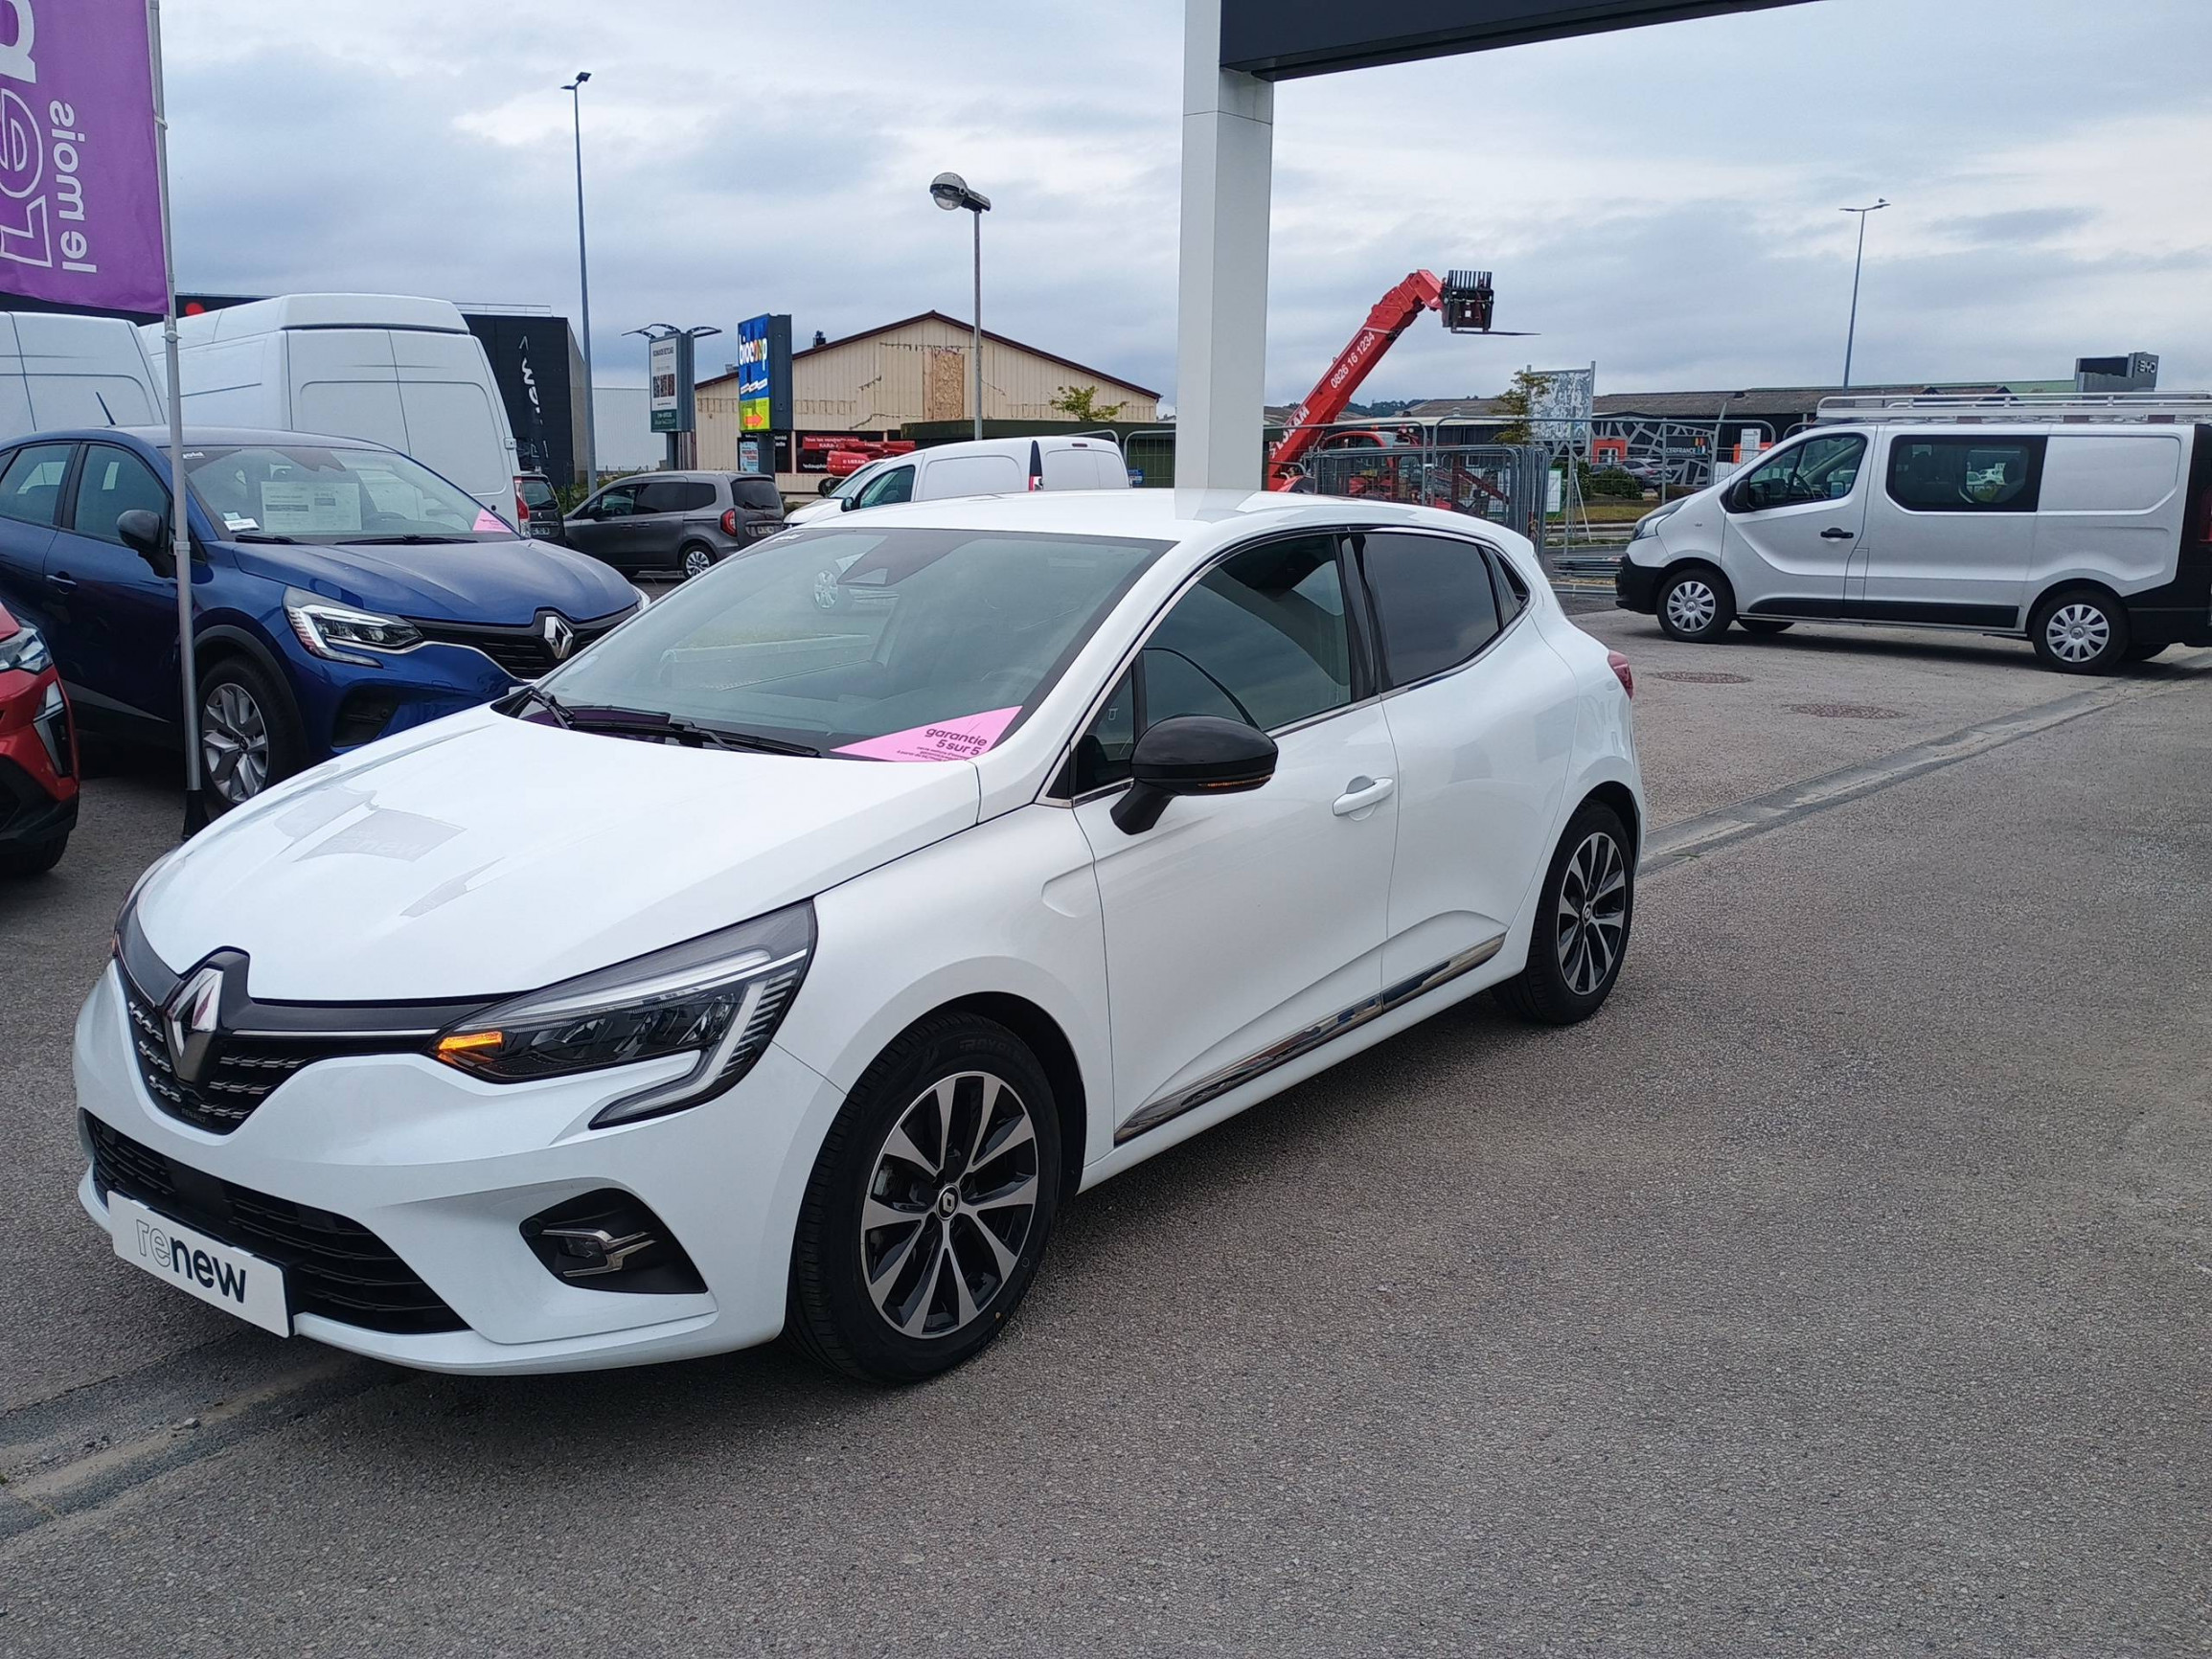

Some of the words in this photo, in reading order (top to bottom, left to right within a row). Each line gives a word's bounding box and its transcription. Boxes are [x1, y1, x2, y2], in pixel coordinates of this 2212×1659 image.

[740, 334, 767, 371] biocoop
[1331, 364, 1349, 388] 0826
[1347, 352, 1358, 368] 16
[1357, 331, 1375, 355] 1234
[924, 728, 988, 746] garantie
[936, 739, 948, 748] 5
[946, 741, 971, 754] sur
[970, 746, 982, 756] 5
[135, 1218, 246, 1304] renew
